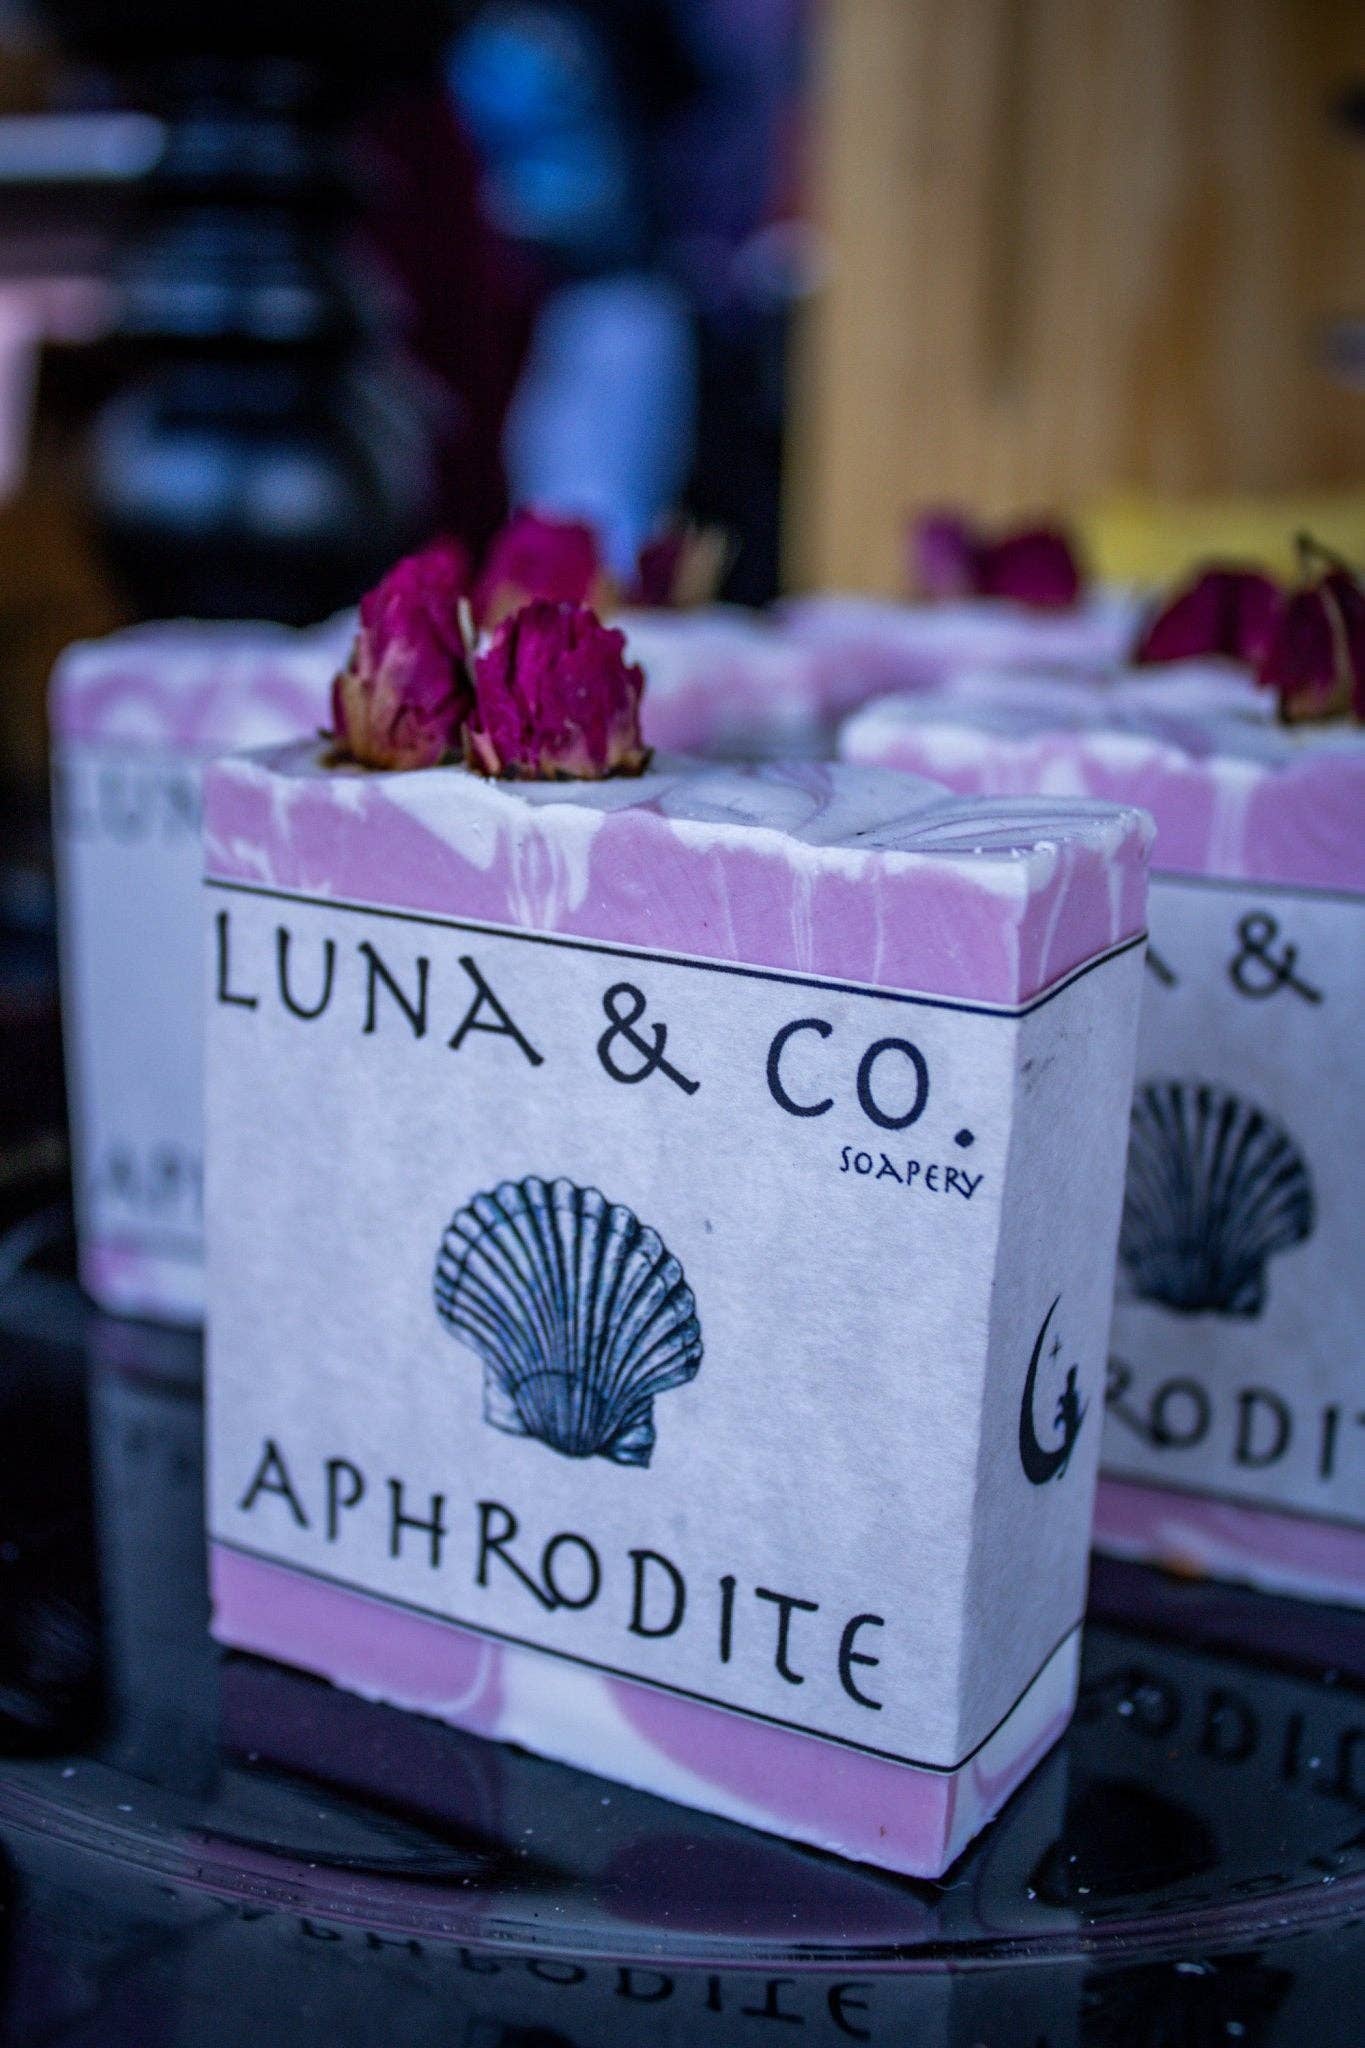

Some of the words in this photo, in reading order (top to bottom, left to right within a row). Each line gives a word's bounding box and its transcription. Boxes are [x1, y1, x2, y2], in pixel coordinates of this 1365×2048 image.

[216, 909, 545, 1067] LUNA
[597, 981, 701, 1096] &
[766, 1017, 975, 1149] CO.
[1228, 911, 1324, 1006] &
[839, 1145, 984, 1201] SOAPERY
[240, 1438, 885, 1711] APHRODITE
